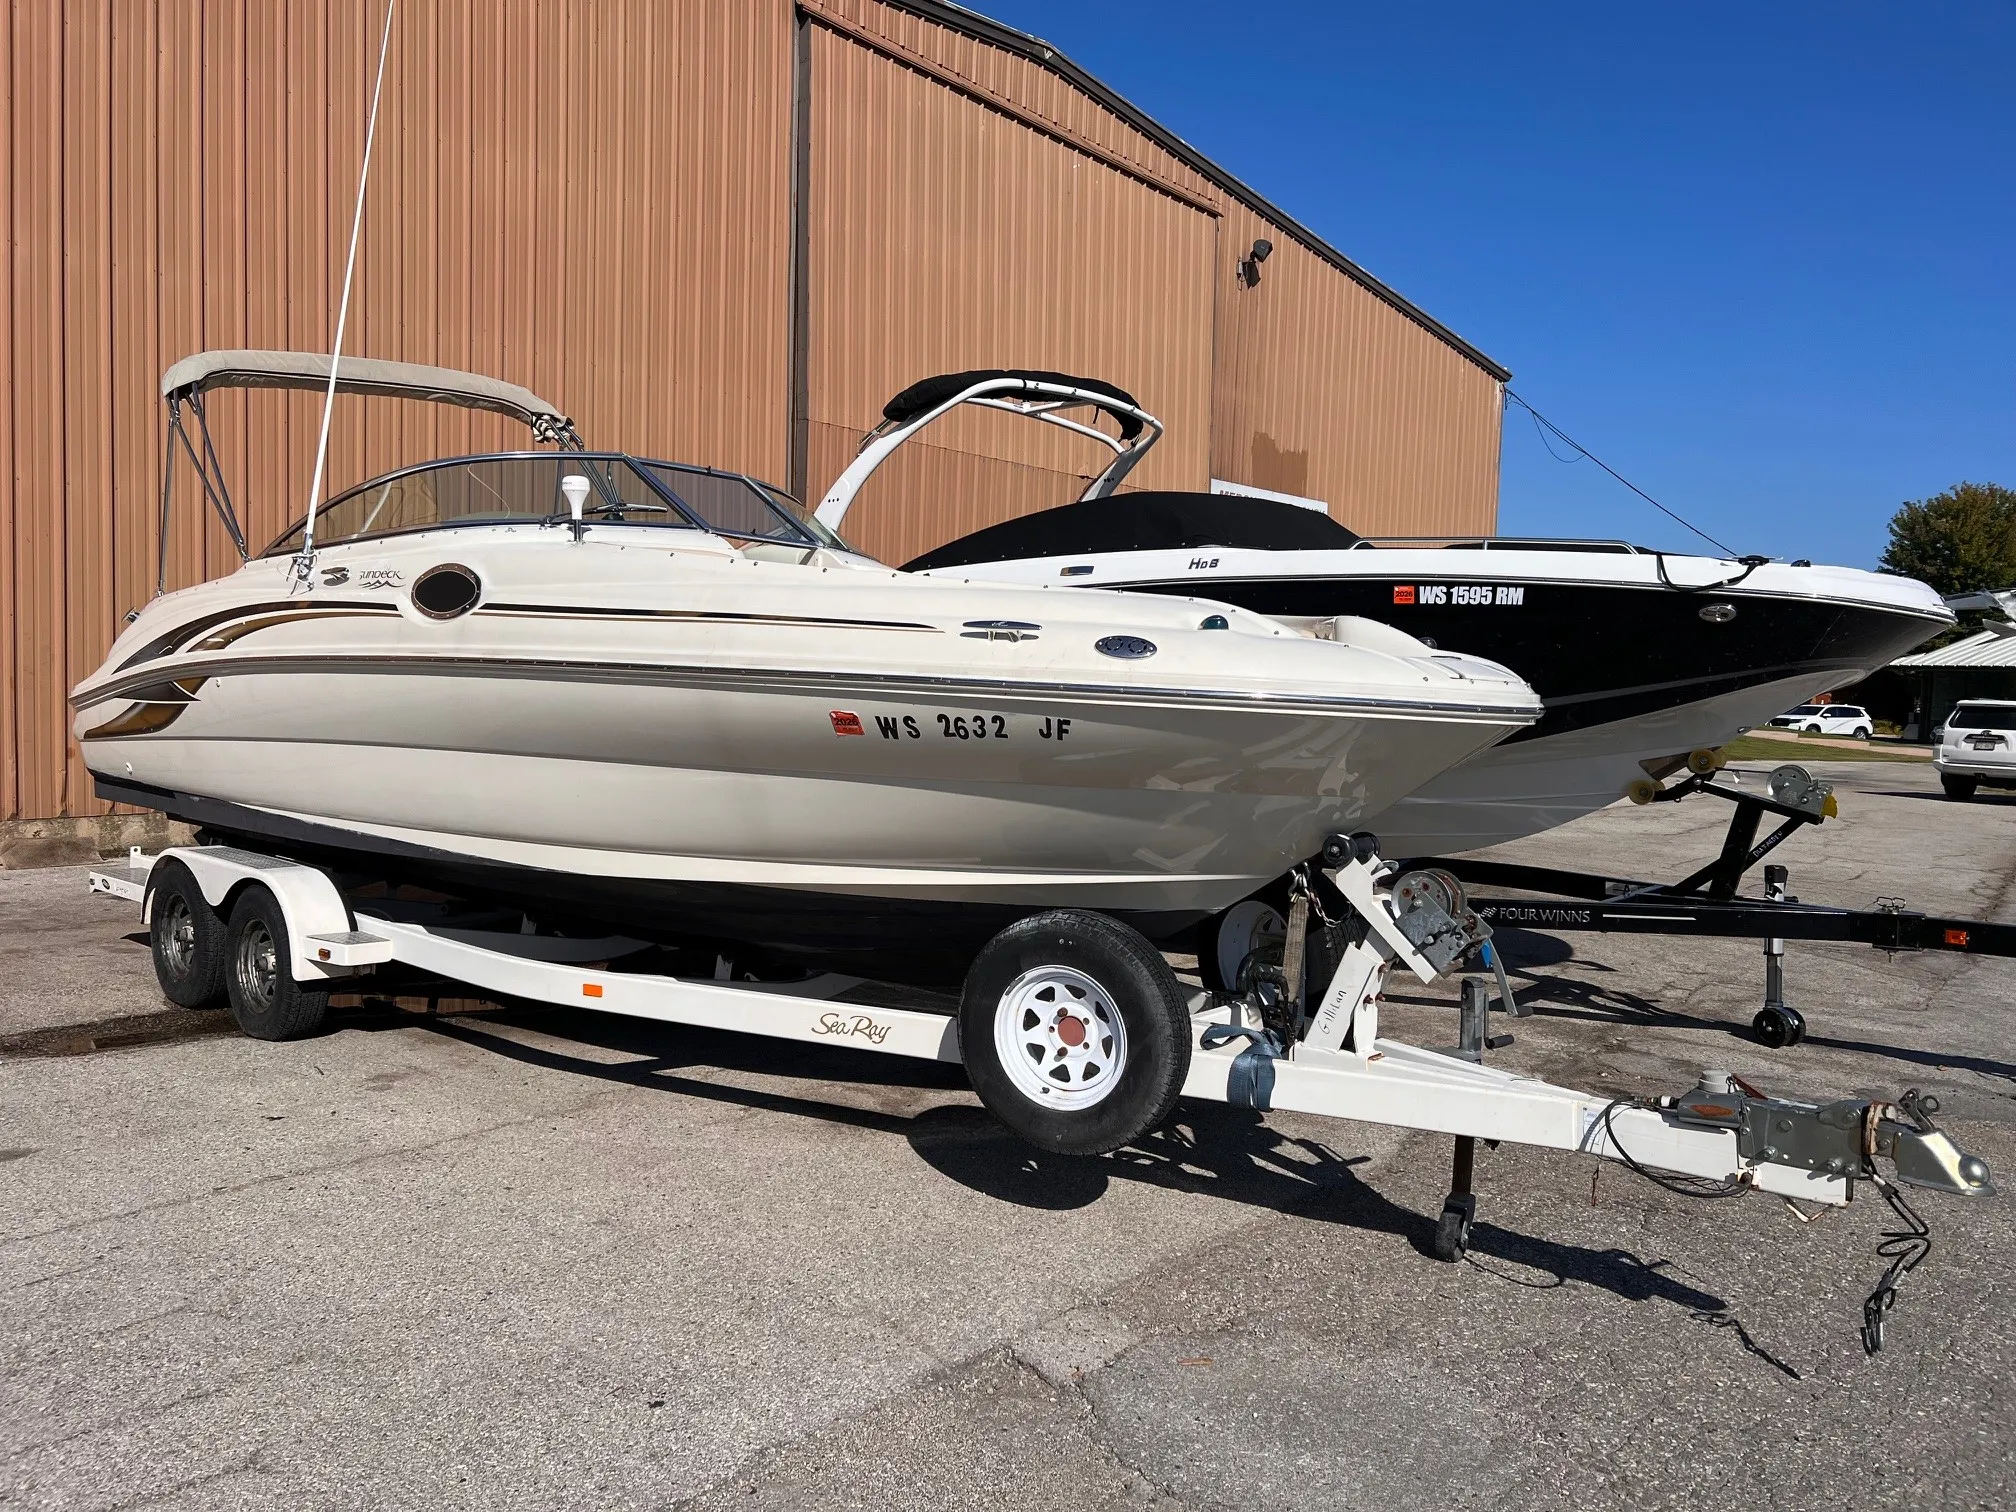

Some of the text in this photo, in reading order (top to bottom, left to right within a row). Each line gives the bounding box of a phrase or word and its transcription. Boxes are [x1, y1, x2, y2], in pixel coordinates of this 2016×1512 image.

[1395, 590, 1413, 598] 2026
[1419, 585, 1524, 606] WS 1595 RM
[834, 717, 859, 726] 2026
[875, 713, 1071, 741] WS 2632 JF
[1499, 907, 1591, 923] FOUR WINNS
[811, 1012, 892, 1044] Sea Ray
